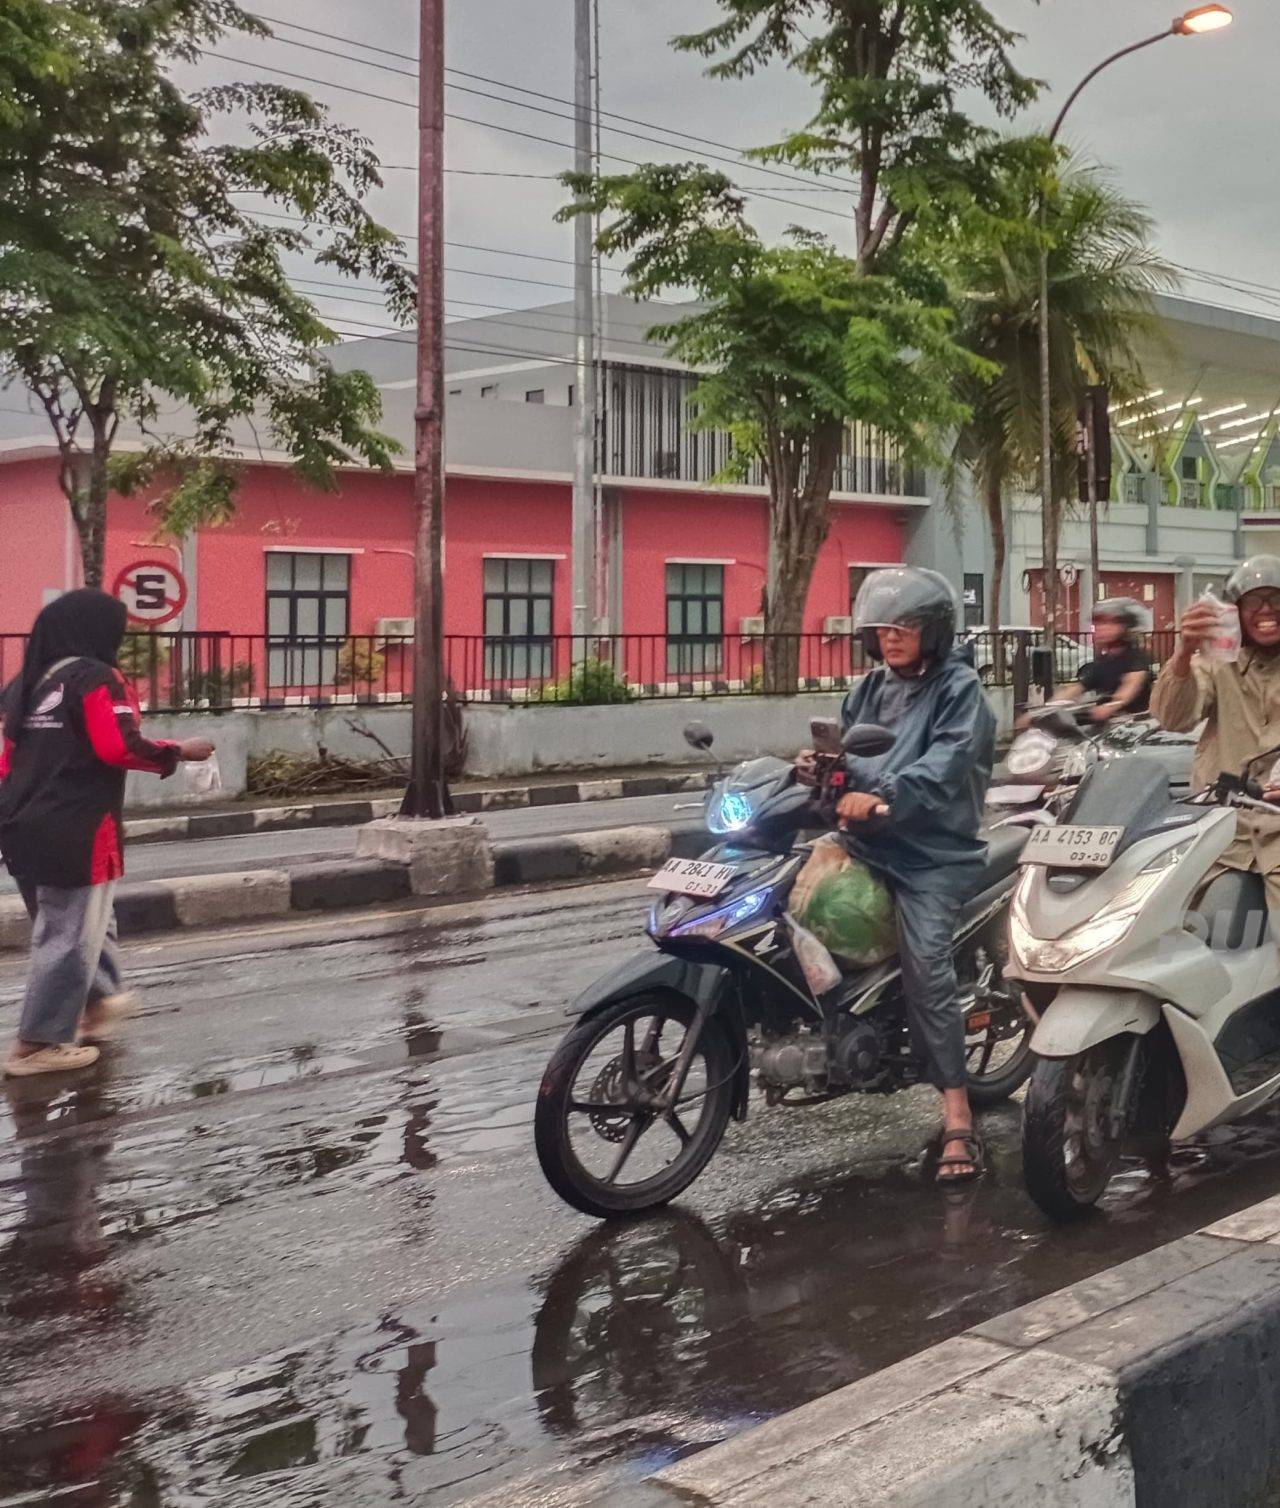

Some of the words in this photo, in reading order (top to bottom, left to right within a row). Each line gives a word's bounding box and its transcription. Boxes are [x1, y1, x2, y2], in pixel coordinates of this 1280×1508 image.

[136, 574, 165, 609] S
[1031, 829, 1051, 844] AA
[1057, 830, 1093, 845] 4153
[662, 860, 682, 873] AA
[681, 862, 715, 877] 2841
[713, 866, 736, 880] HV
